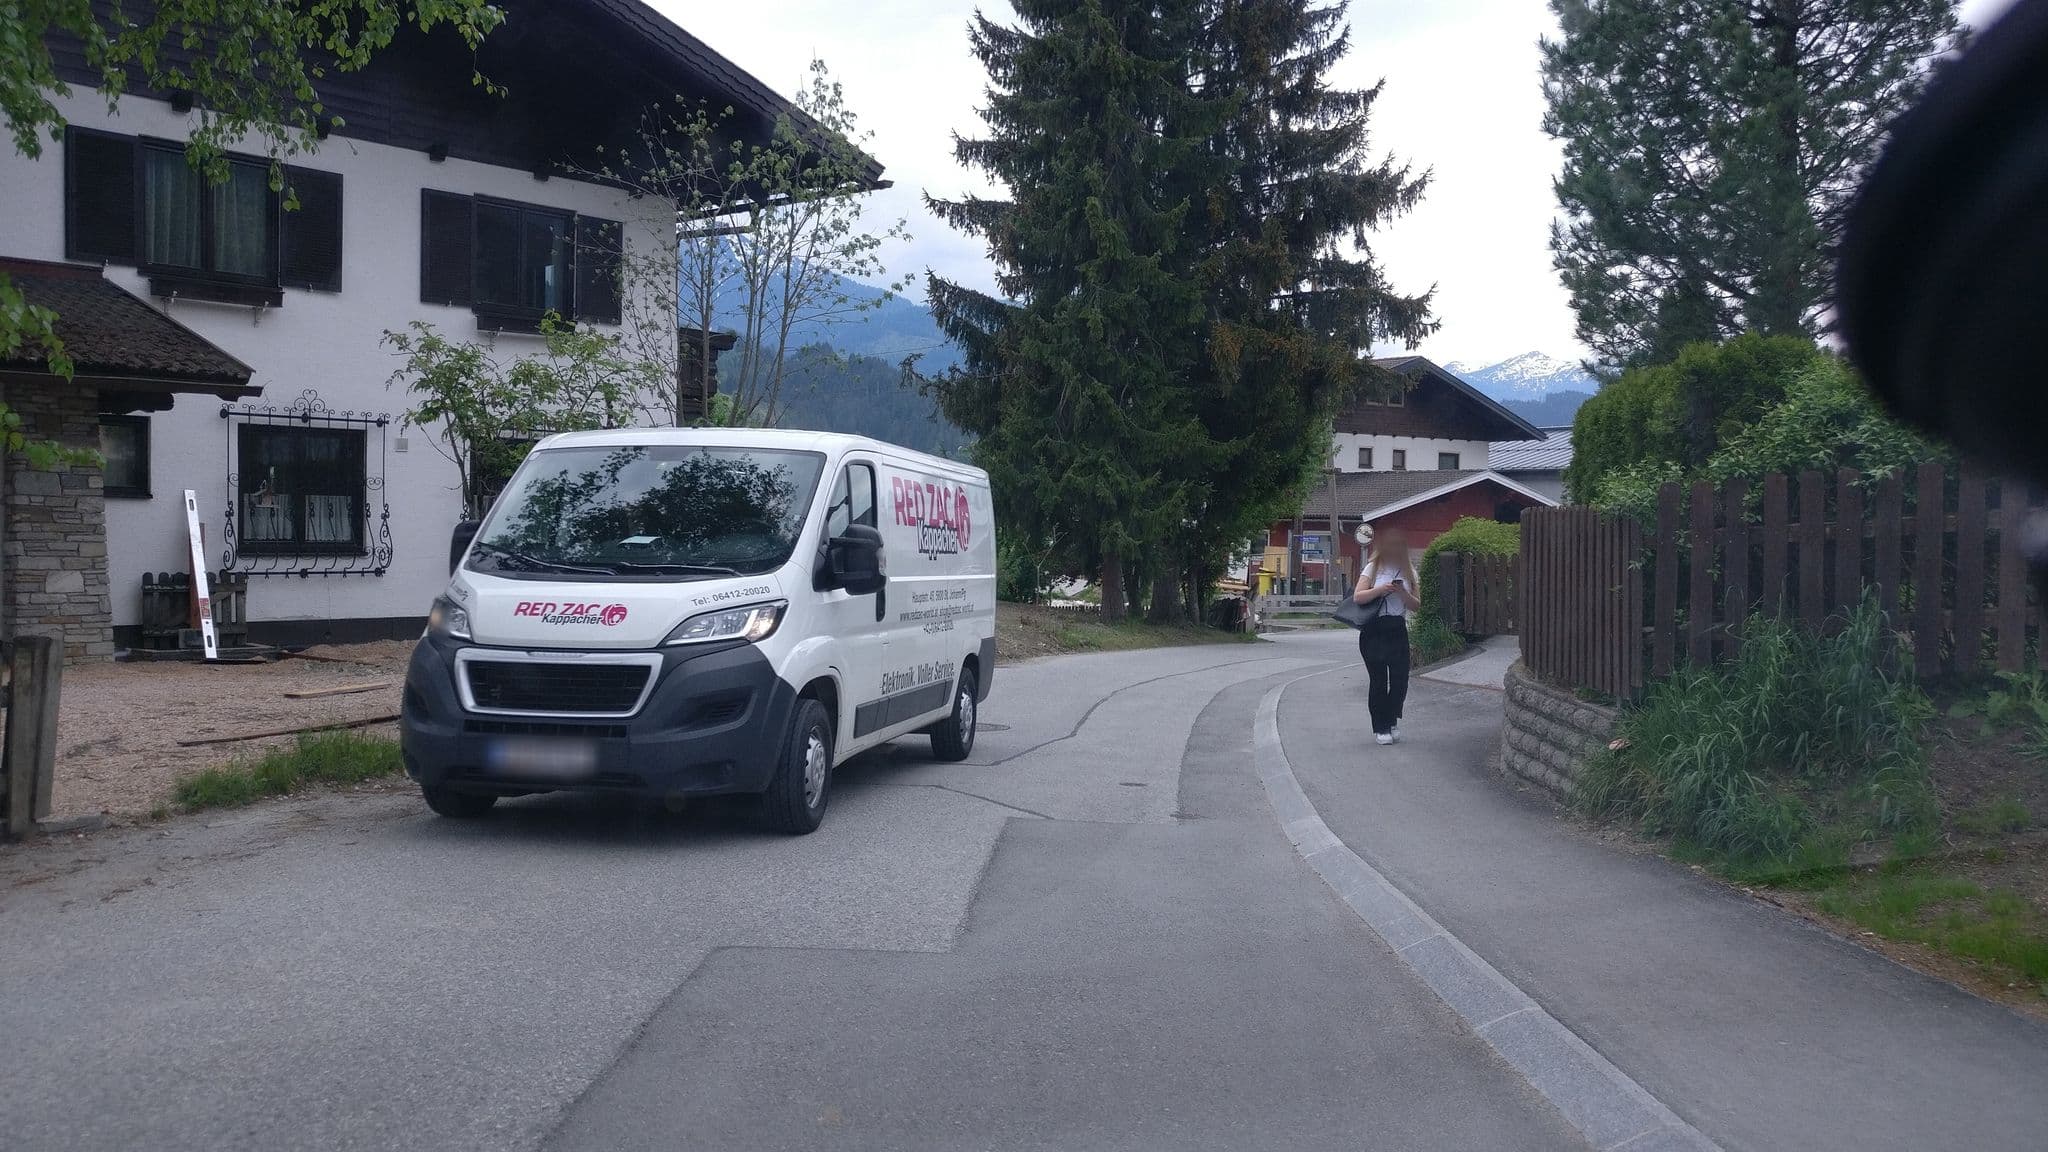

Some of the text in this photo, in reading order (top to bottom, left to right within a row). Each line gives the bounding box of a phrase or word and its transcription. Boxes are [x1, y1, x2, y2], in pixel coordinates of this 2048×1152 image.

[892, 476, 955, 529] RED ZAC
[917, 517, 957, 560] Kappacher
[692, 586, 771, 607] Tel: 06412-20020
[513, 601, 600, 616] RED ZAC
[541, 613, 601, 625] Kappacher
[918, 663, 933, 684] Voller
